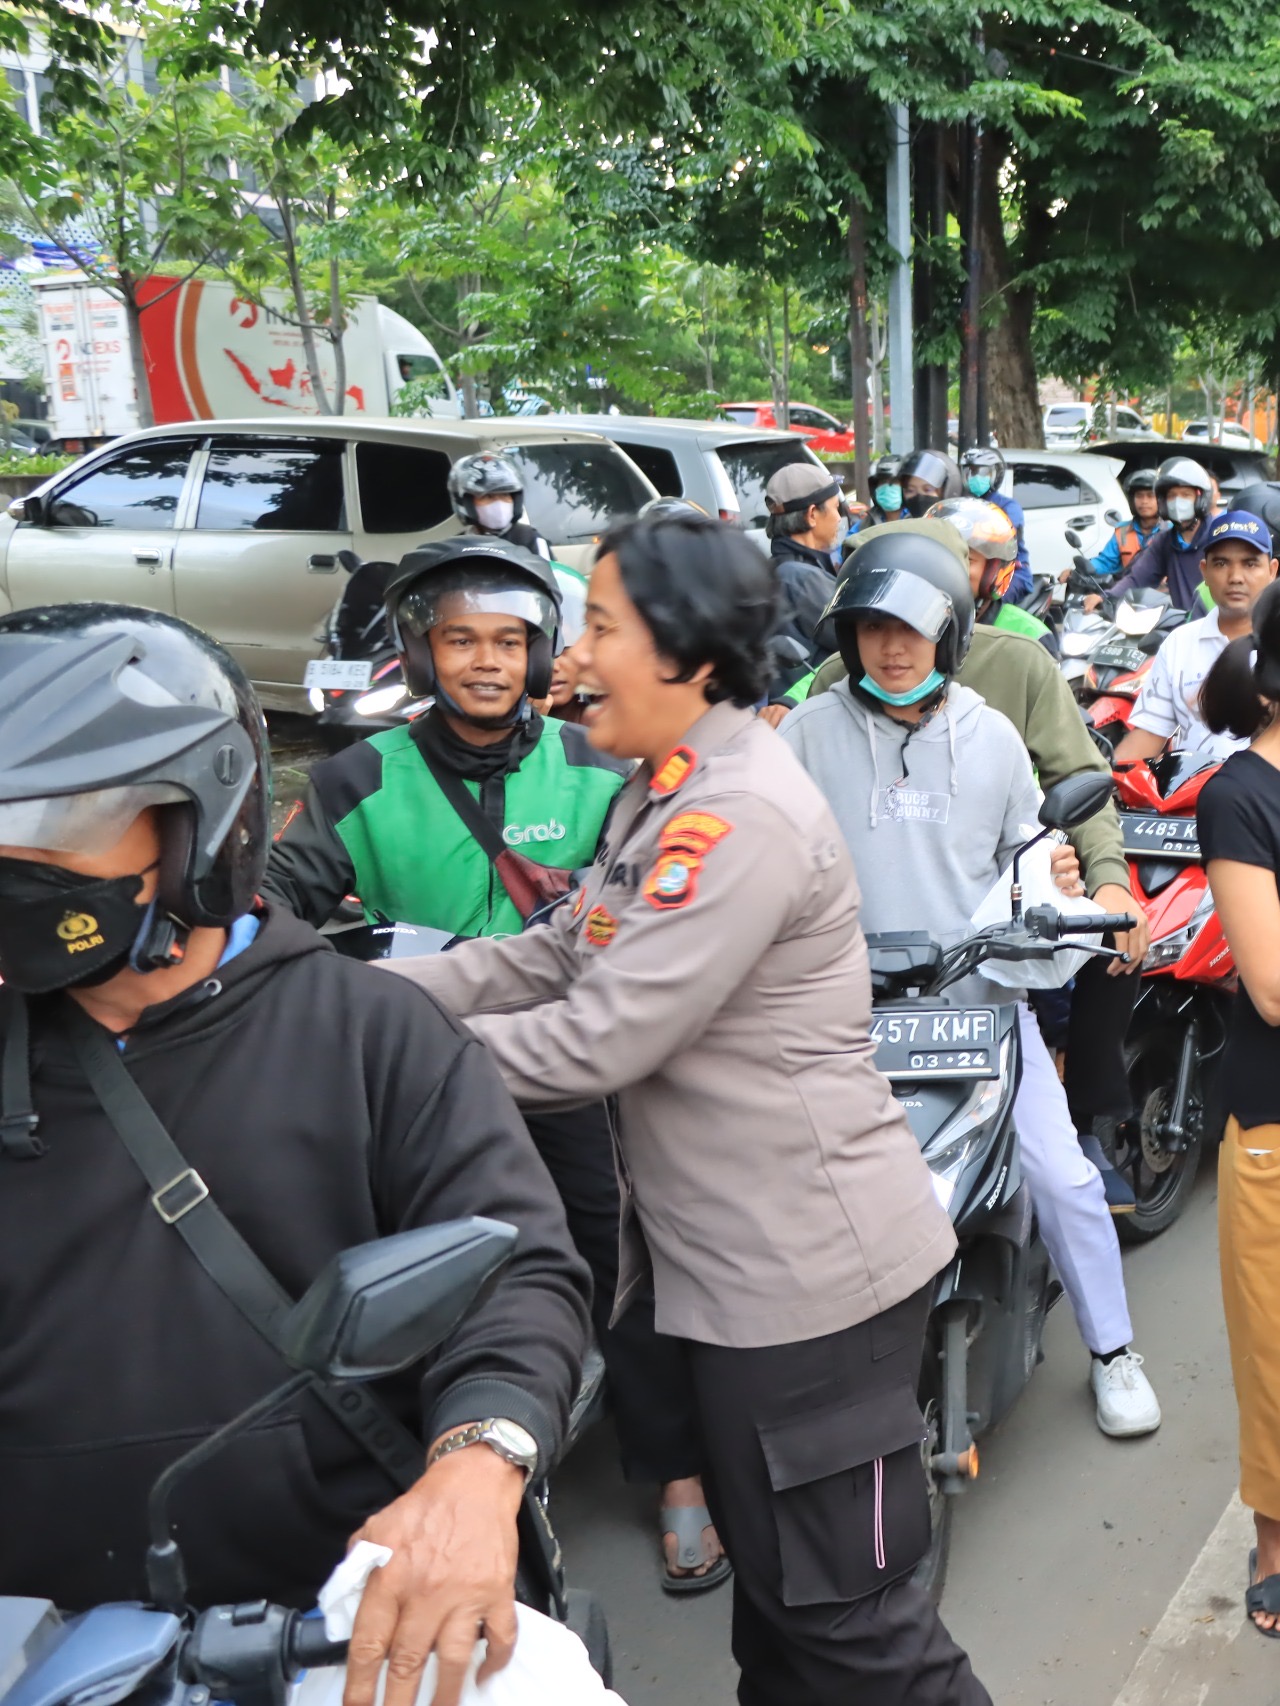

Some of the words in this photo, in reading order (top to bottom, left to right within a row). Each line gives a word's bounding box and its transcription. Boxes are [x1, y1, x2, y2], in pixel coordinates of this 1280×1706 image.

[896, 792, 930, 806] BUGS
[895, 805, 940, 819] BUNNY
[502, 818, 566, 845] Grab
[1134, 821, 1179, 837] 4485
[372, 927, 418, 937] HONDA
[67, 934, 105, 955] POLRI
[932, 1017, 987, 1042] KMF
[986, 1165, 1008, 1210] HONDA
